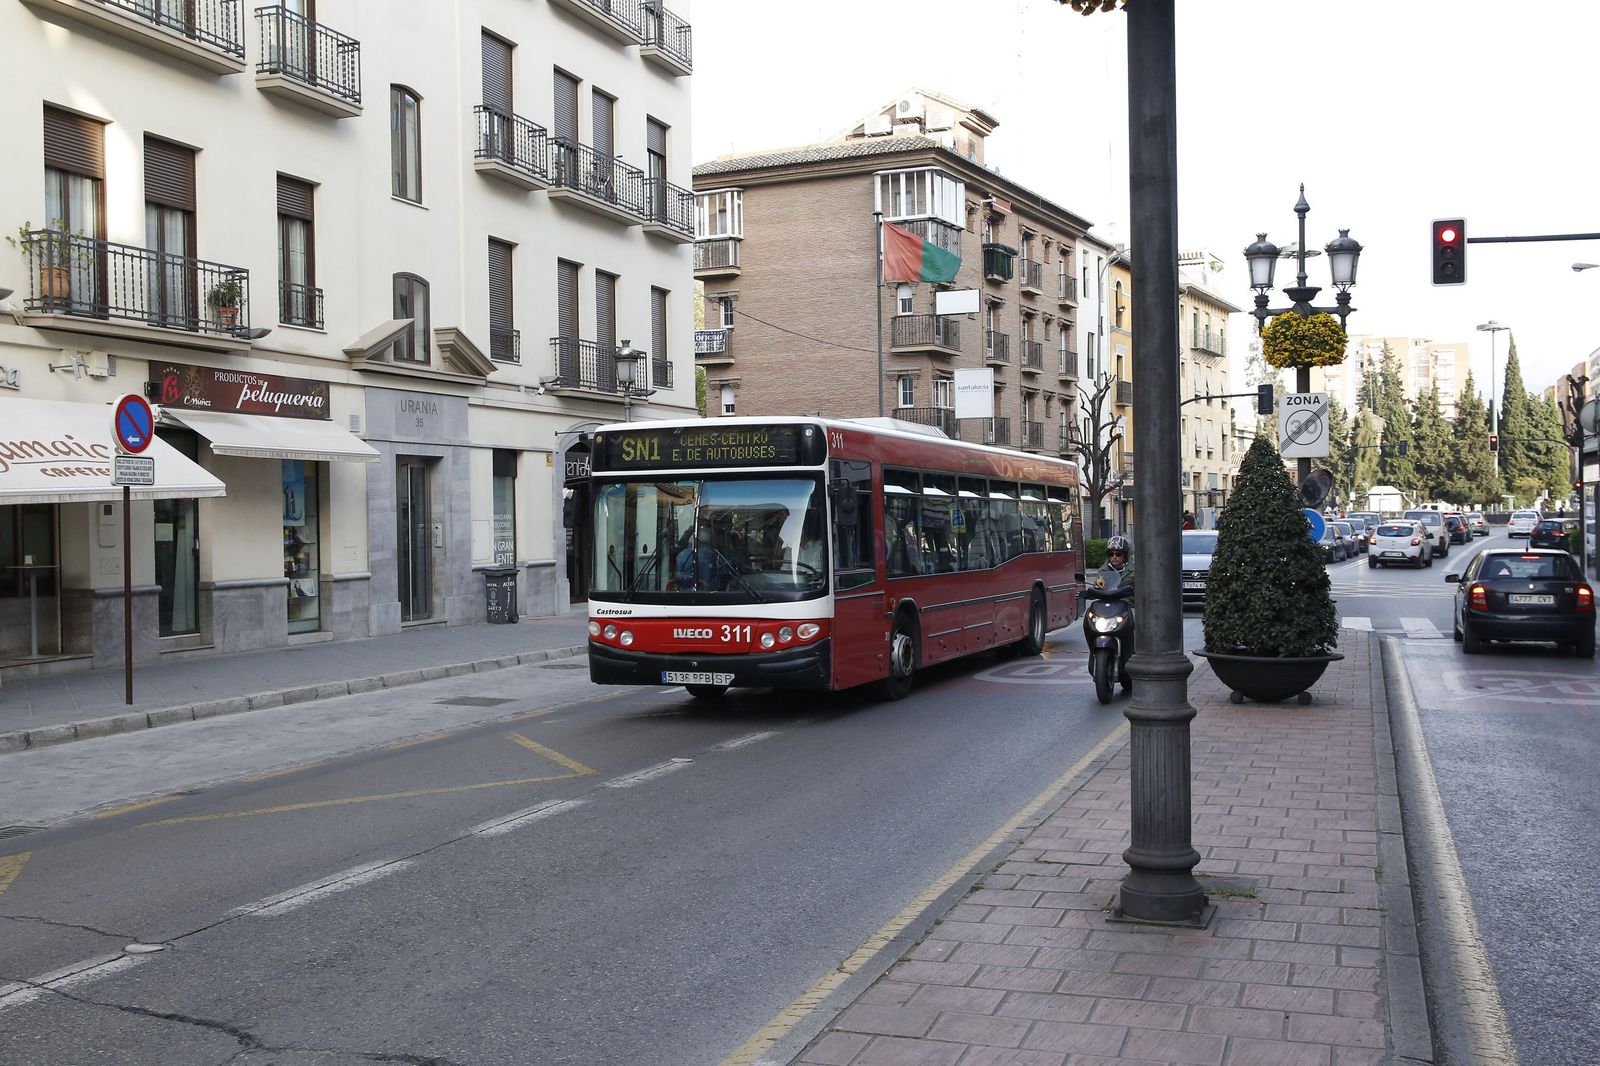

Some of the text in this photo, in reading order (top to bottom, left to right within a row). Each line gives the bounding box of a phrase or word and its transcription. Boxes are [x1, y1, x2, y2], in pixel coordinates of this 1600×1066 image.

[215, 372, 257, 385] PRODUCTOS
[236, 382, 325, 412] peluquería
[1286, 396, 1321, 406] ZONA
[400, 399, 439, 416] URANIA
[415, 418, 424, 428] 35
[1290, 420, 1318, 434] 30
[831, 432, 844, 449] 311
[622, 437, 661, 461] SN1
[687, 448, 701, 460] DE
[706, 446, 776, 460] AUTOBUSES
[498, 541, 514, 551] GRAN
[673, 628, 713, 639] IVECO
[720, 624, 751, 643] 311
[715, 674, 732, 684] SP
